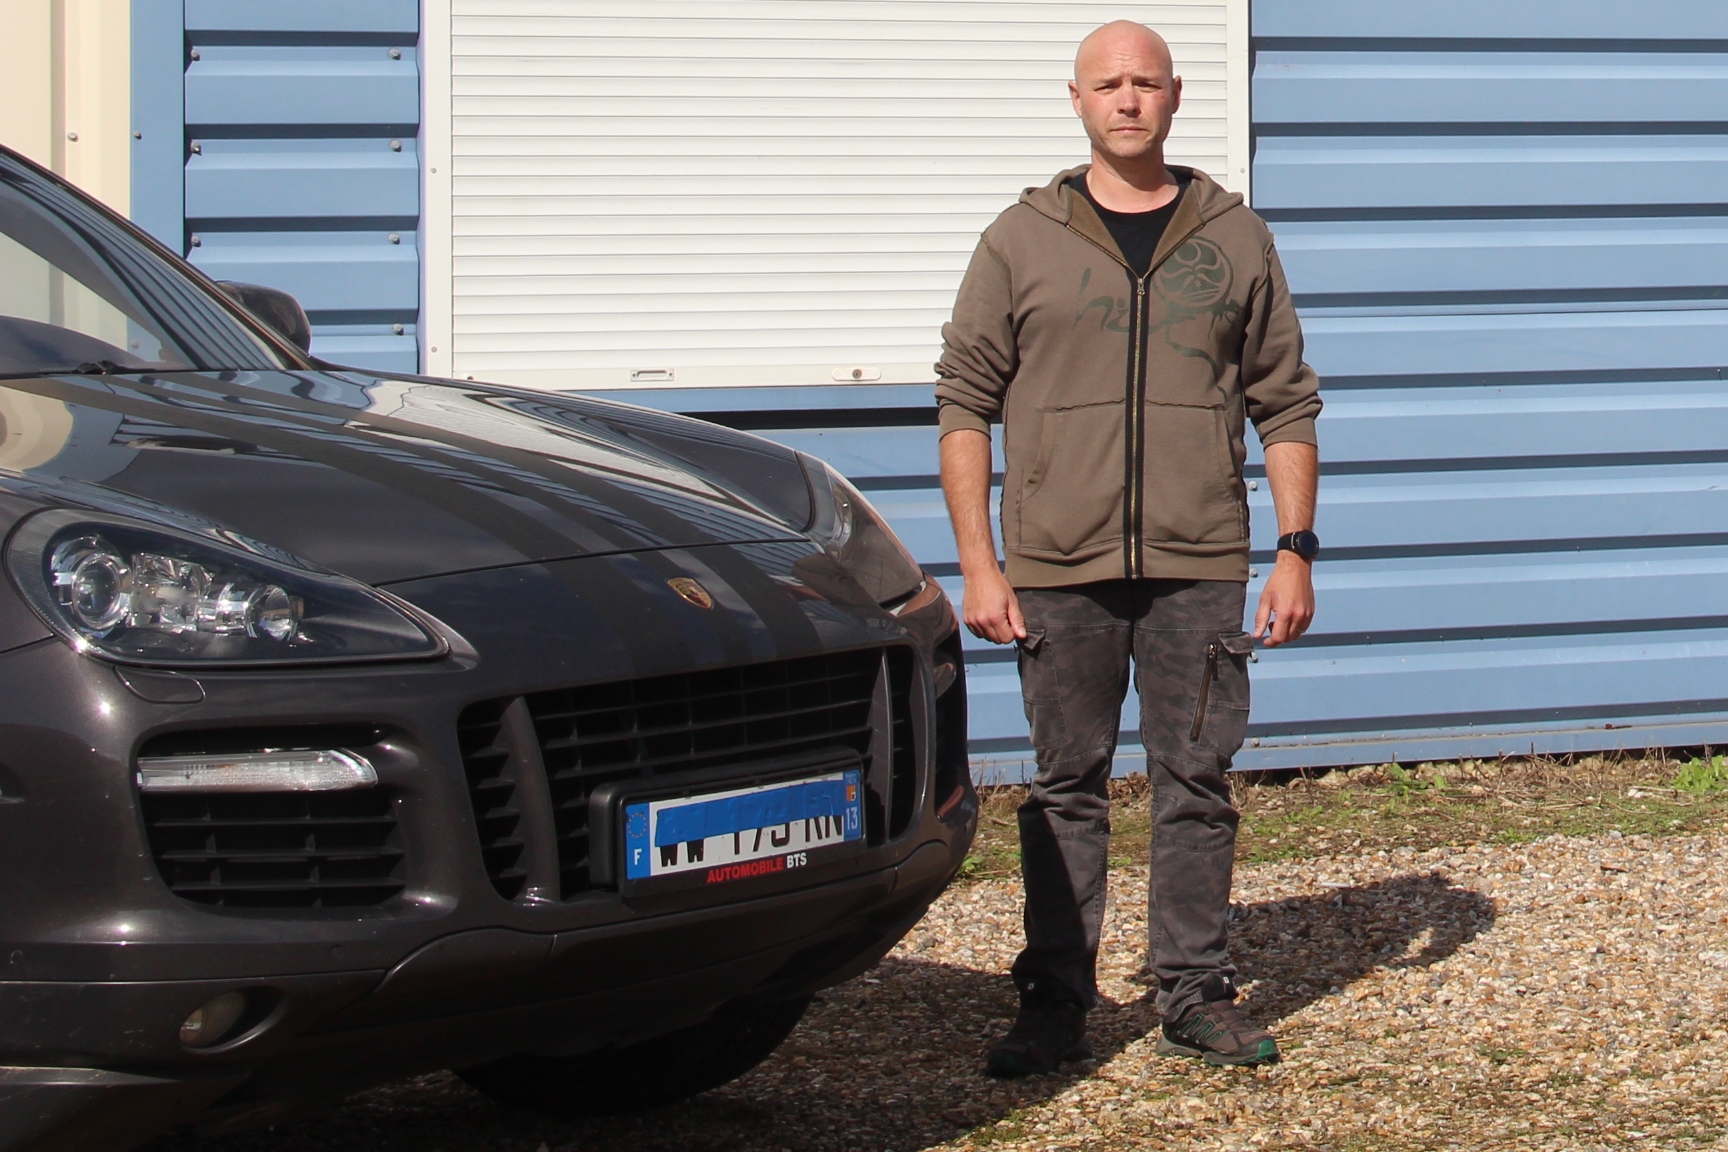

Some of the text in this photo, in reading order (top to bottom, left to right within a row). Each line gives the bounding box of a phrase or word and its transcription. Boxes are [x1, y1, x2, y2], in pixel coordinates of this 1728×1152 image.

[846, 807, 858, 830] 13
[634, 848, 642, 866] F
[707, 852, 808, 884] AUTOMOBILE BTS
